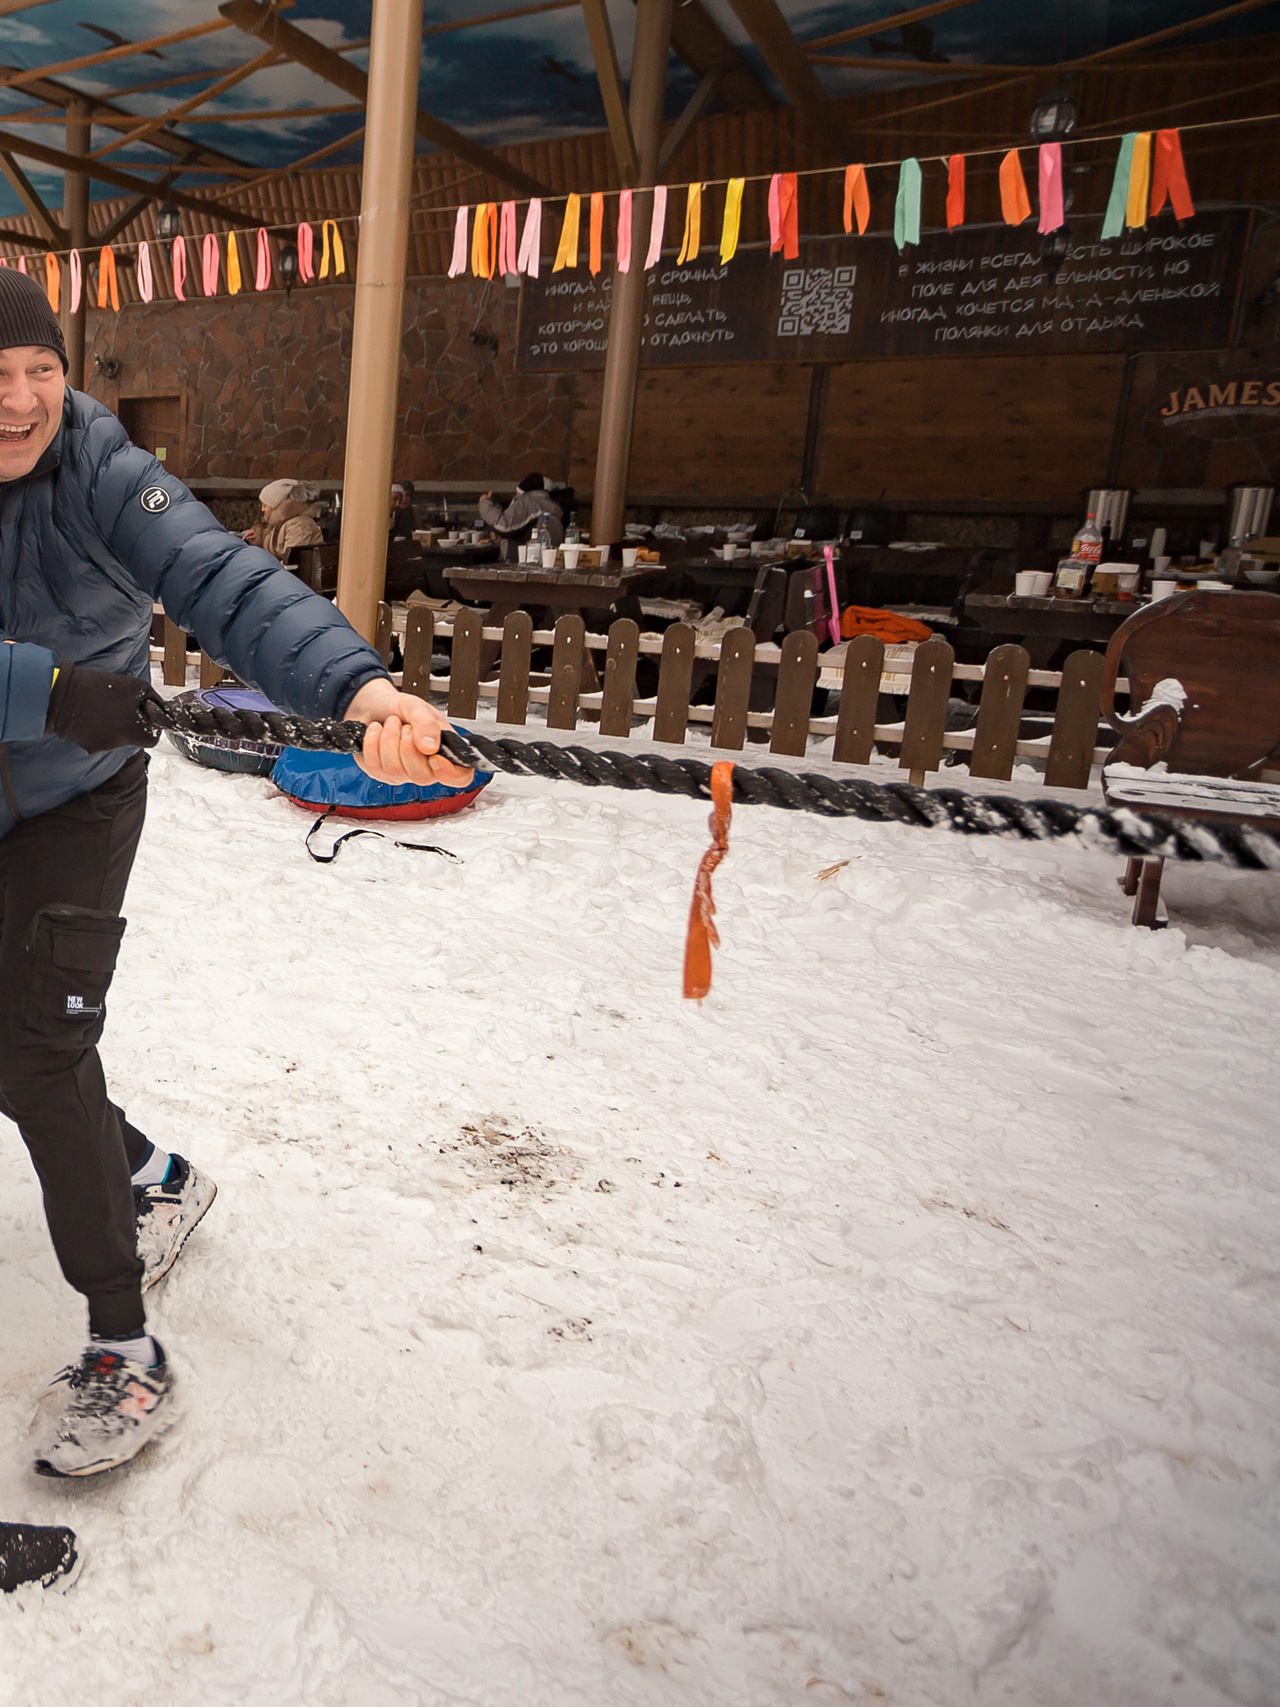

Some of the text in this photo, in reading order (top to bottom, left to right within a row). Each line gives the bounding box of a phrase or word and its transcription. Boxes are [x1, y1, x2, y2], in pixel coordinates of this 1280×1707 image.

[915, 258, 974, 274] ЖИЗНИ
[980, 252, 1042, 269] ВСЕГД
[1120, 233, 1216, 256] ШИРОКОЕ
[545, 280, 597, 296] ИНОГДА
[661, 266, 729, 286] СРОЧНАЯ
[912, 282, 955, 298] ПОЛЕ
[961, 278, 998, 297] ДЛЯ
[1163, 259, 1190, 276] НО
[880, 304, 947, 323] ИНОГДА
[955, 297, 1035, 316] ХОЧЕТСЯ
[538, 318, 604, 336] КОТОРУЮ
[934, 312, 1144, 342] ПОЛЯНКИ ДЛЯ ОТДЫХА
[530, 341, 558, 356] ЭТО
[650, 329, 735, 348] ОТДОХНУТЬ
[1160, 380, 1280, 417] JAMES
